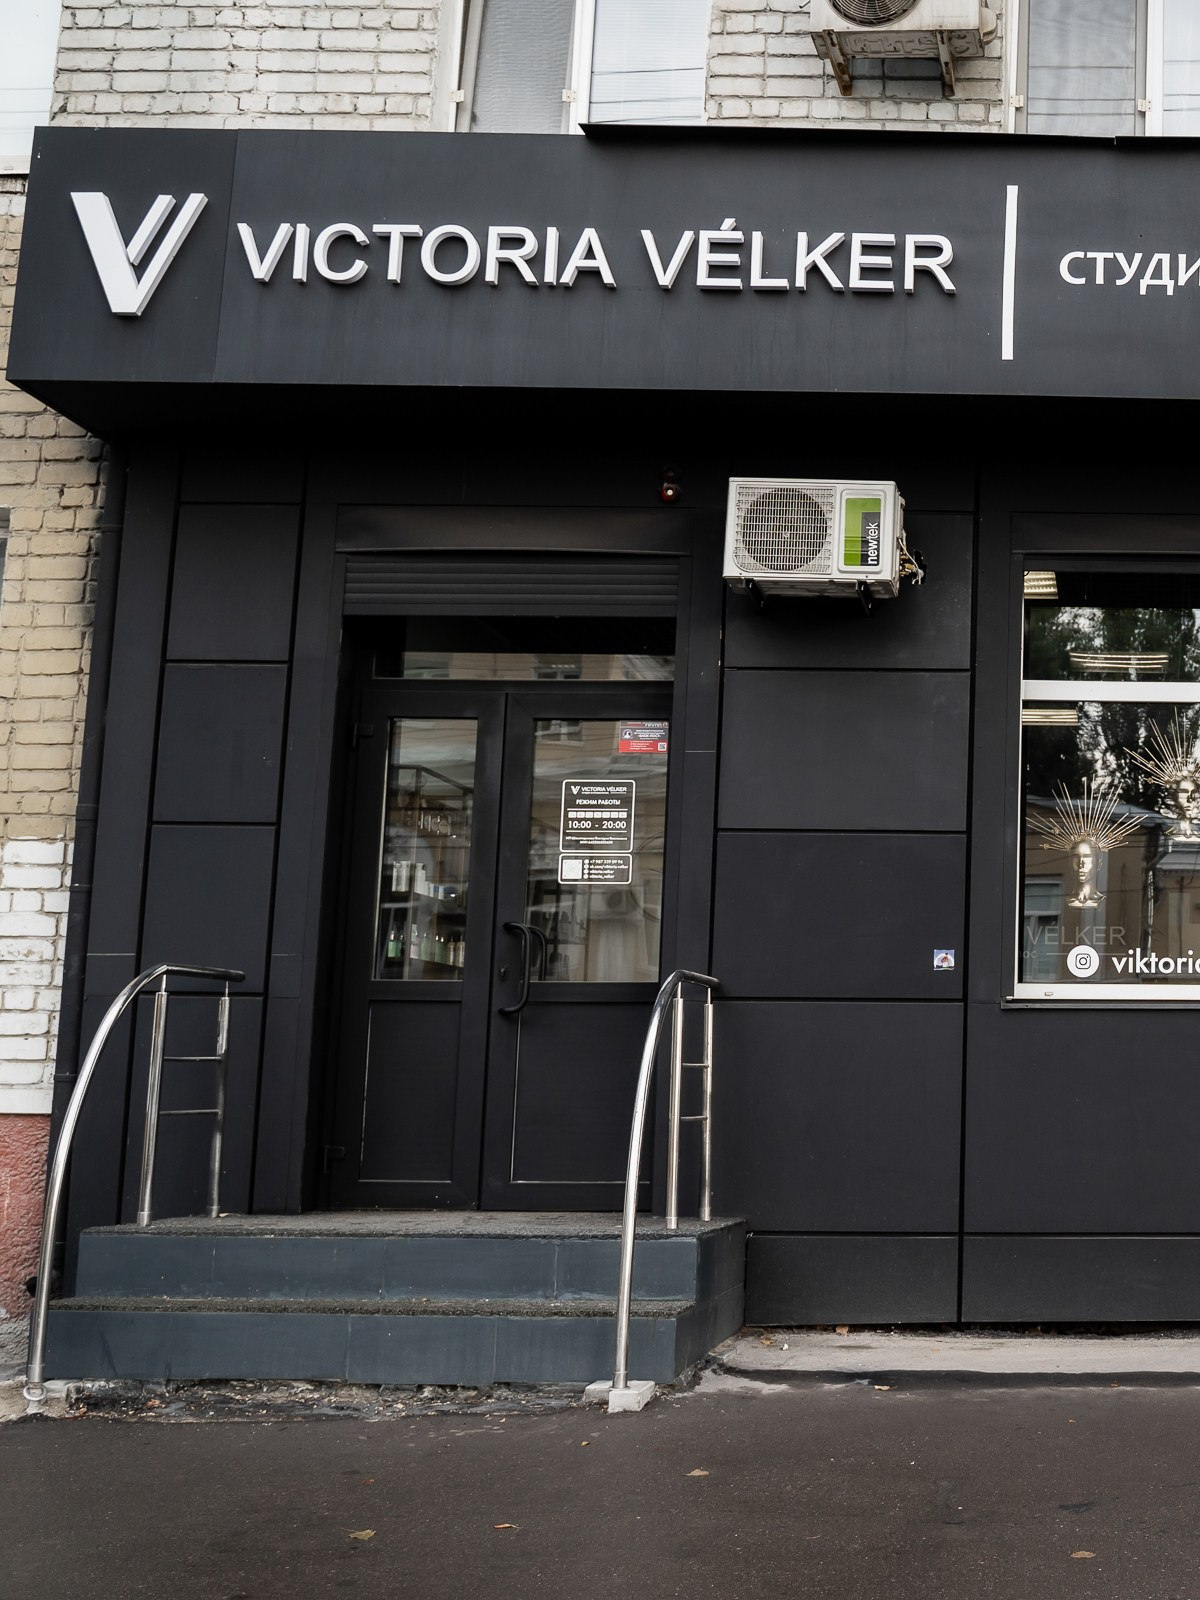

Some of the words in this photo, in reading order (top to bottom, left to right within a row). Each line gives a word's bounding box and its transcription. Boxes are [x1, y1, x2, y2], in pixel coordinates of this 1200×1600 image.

[236, 222, 617, 288] VICTORIA
[641, 217, 957, 295] VÉLKER
[865, 521, 879, 565] newtek
[568, 820, 592, 829] 10:00
[602, 820, 627, 829] 20:00
[1026, 920, 1127, 945] VÉLKER
